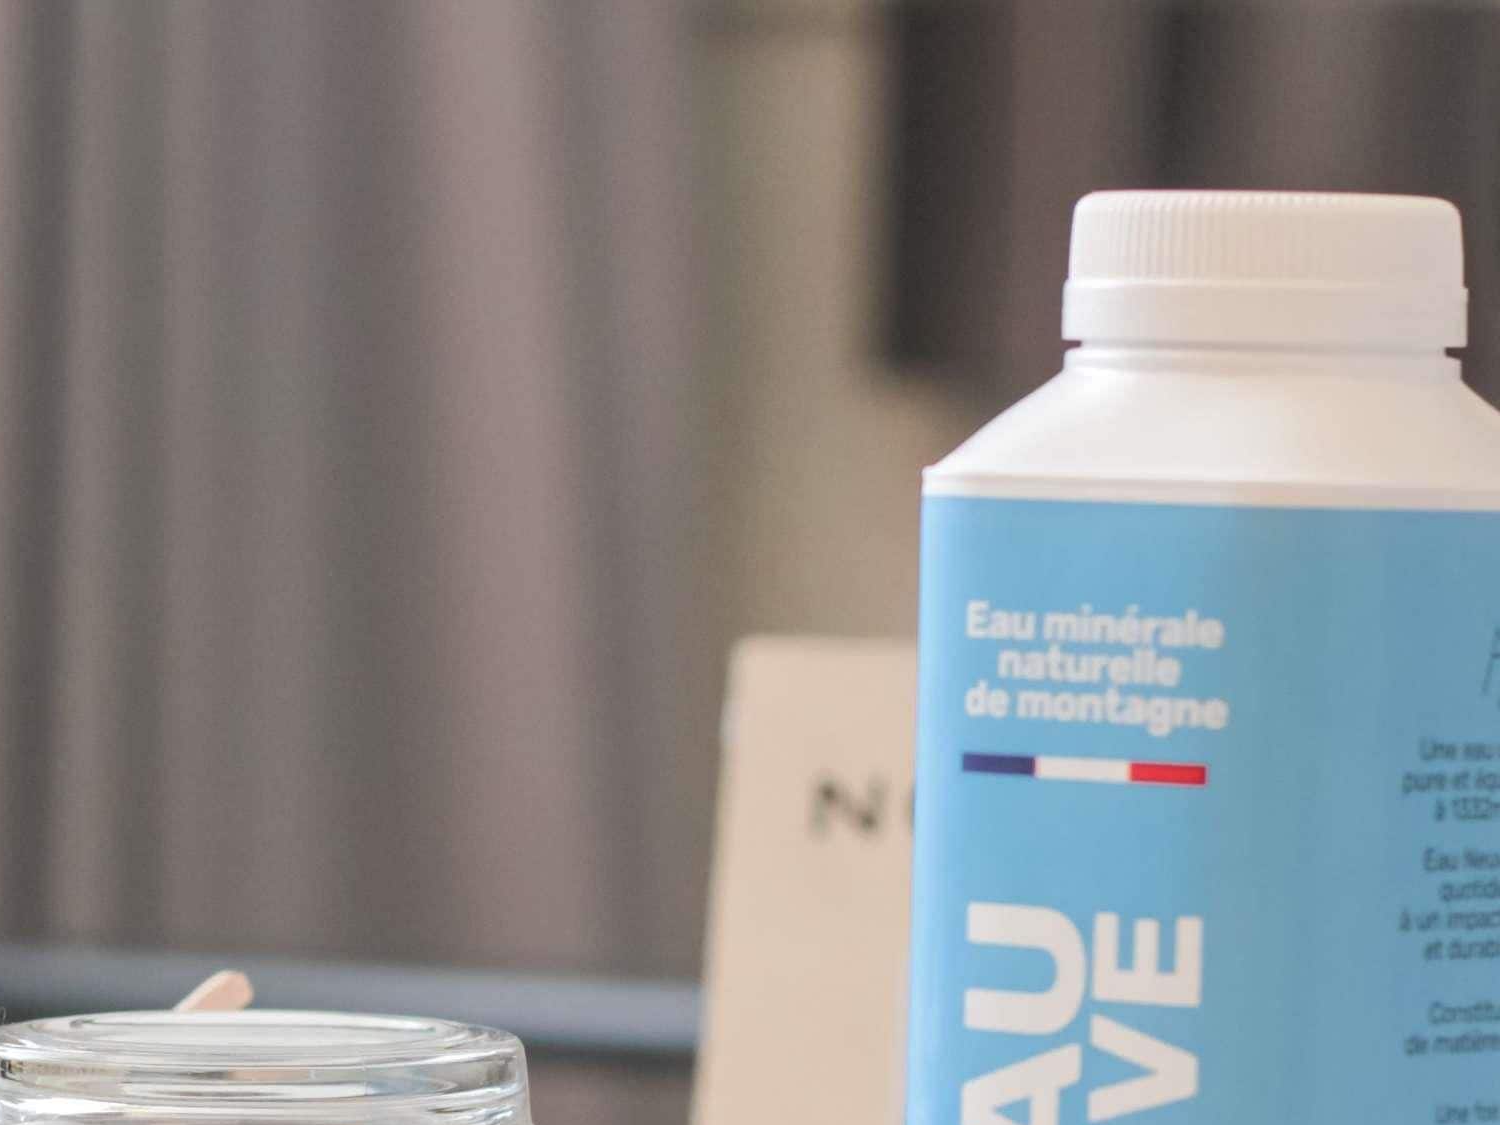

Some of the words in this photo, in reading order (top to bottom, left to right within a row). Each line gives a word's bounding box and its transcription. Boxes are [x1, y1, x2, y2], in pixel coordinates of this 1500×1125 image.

[965, 600, 1036, 641] Eau
[1043, 604, 1225, 650] minérale
[998, 646, 1182, 689] naturelle
[964, 682, 1008, 719] de
[1015, 688, 1230, 737] montagne
